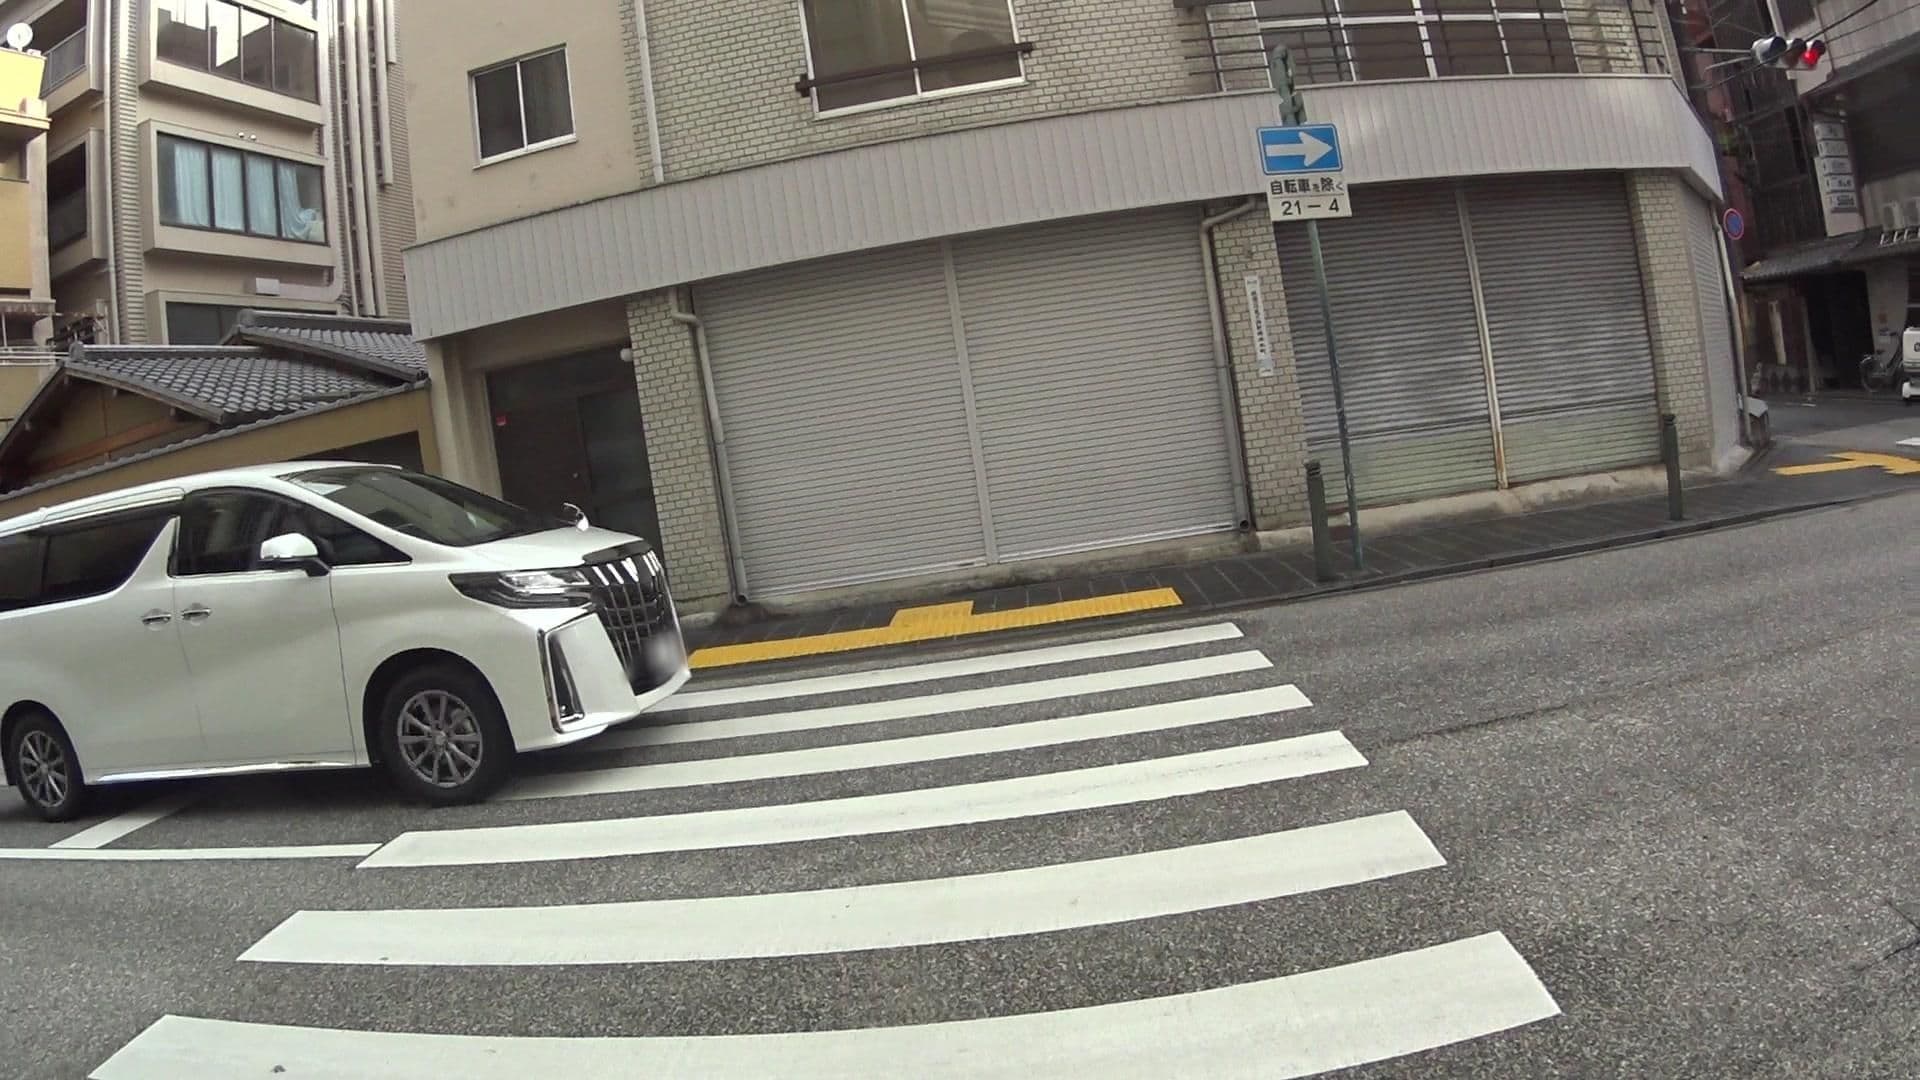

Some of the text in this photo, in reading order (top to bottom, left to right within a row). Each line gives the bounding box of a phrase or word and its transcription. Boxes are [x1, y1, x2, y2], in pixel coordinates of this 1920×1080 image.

[1270, 177, 1344, 195] 自転車を除く
